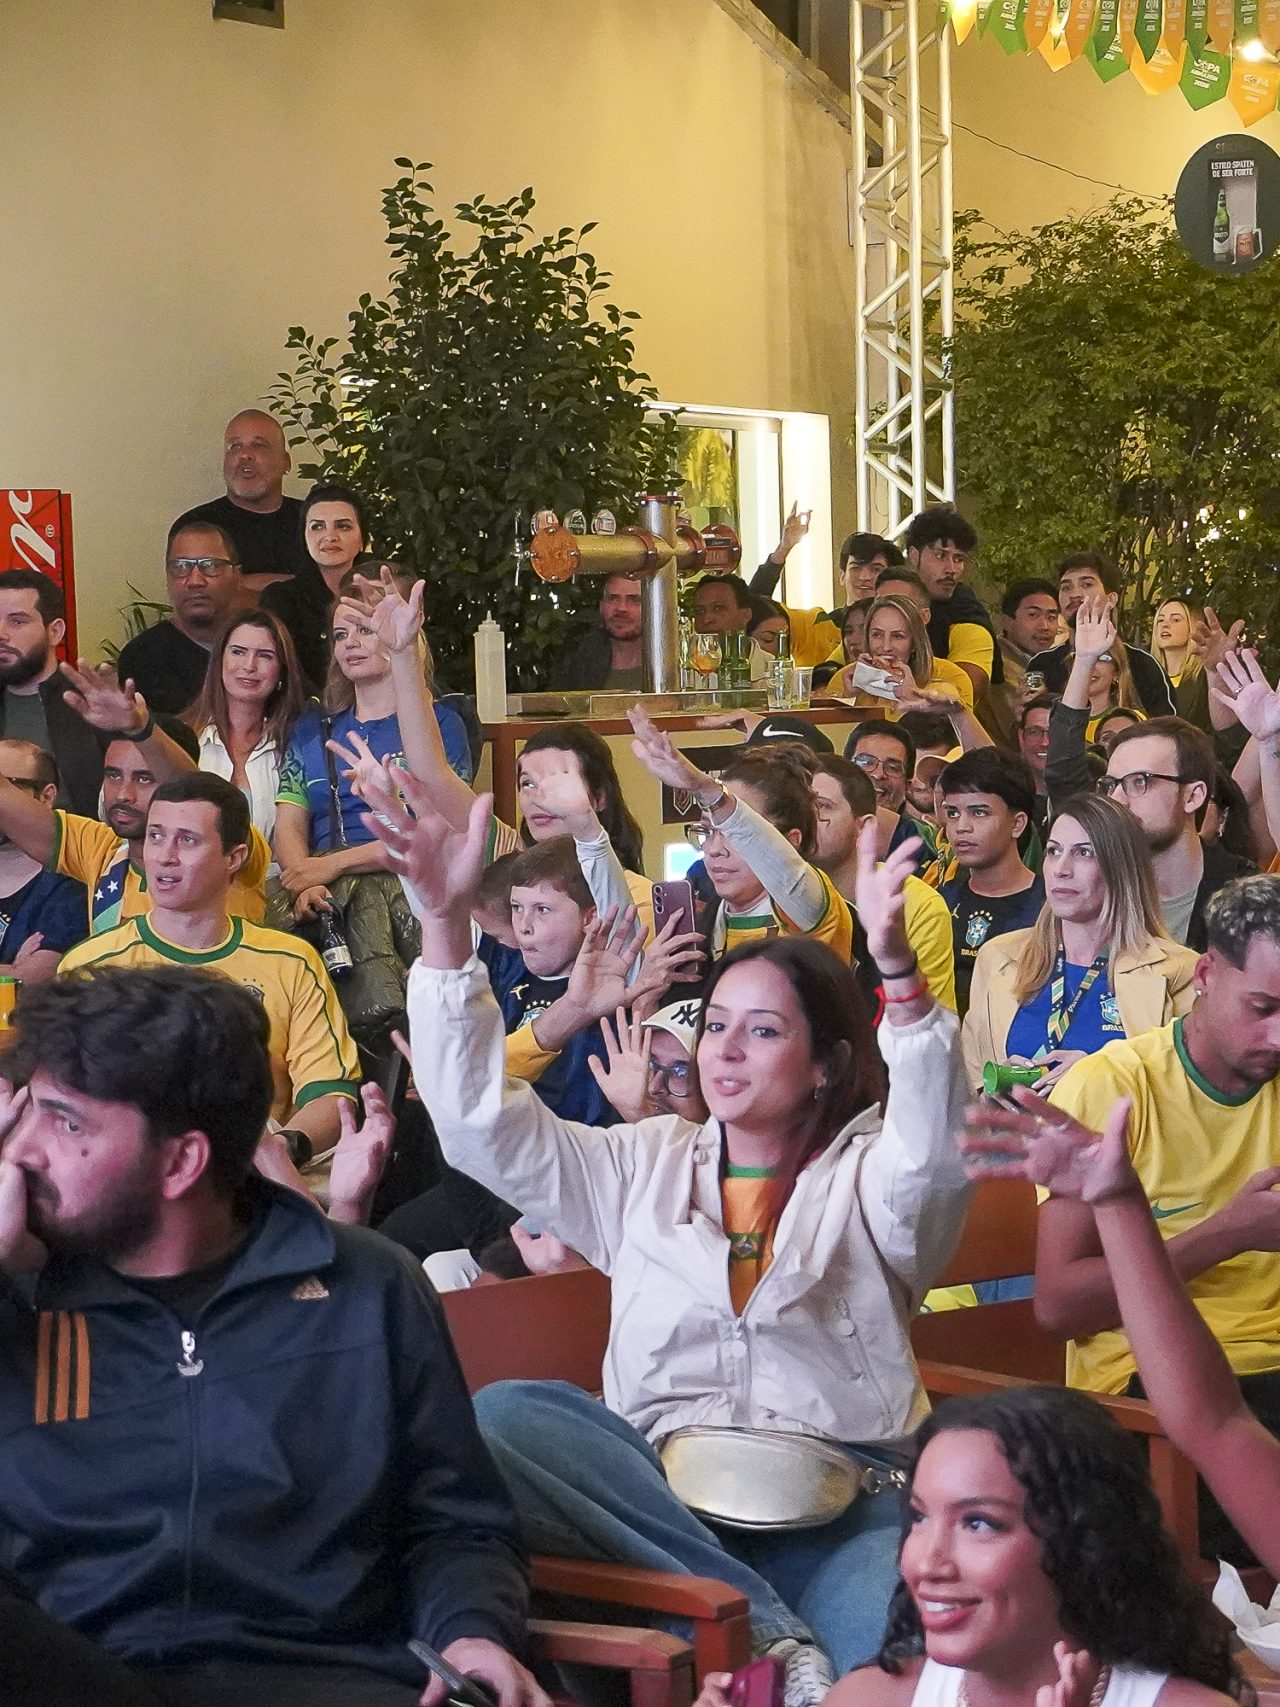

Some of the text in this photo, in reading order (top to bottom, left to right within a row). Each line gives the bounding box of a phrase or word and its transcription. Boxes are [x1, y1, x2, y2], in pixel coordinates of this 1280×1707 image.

[1194, 59, 1220, 74] COPA
[1212, 168, 1253, 178] DE SER FORTE
